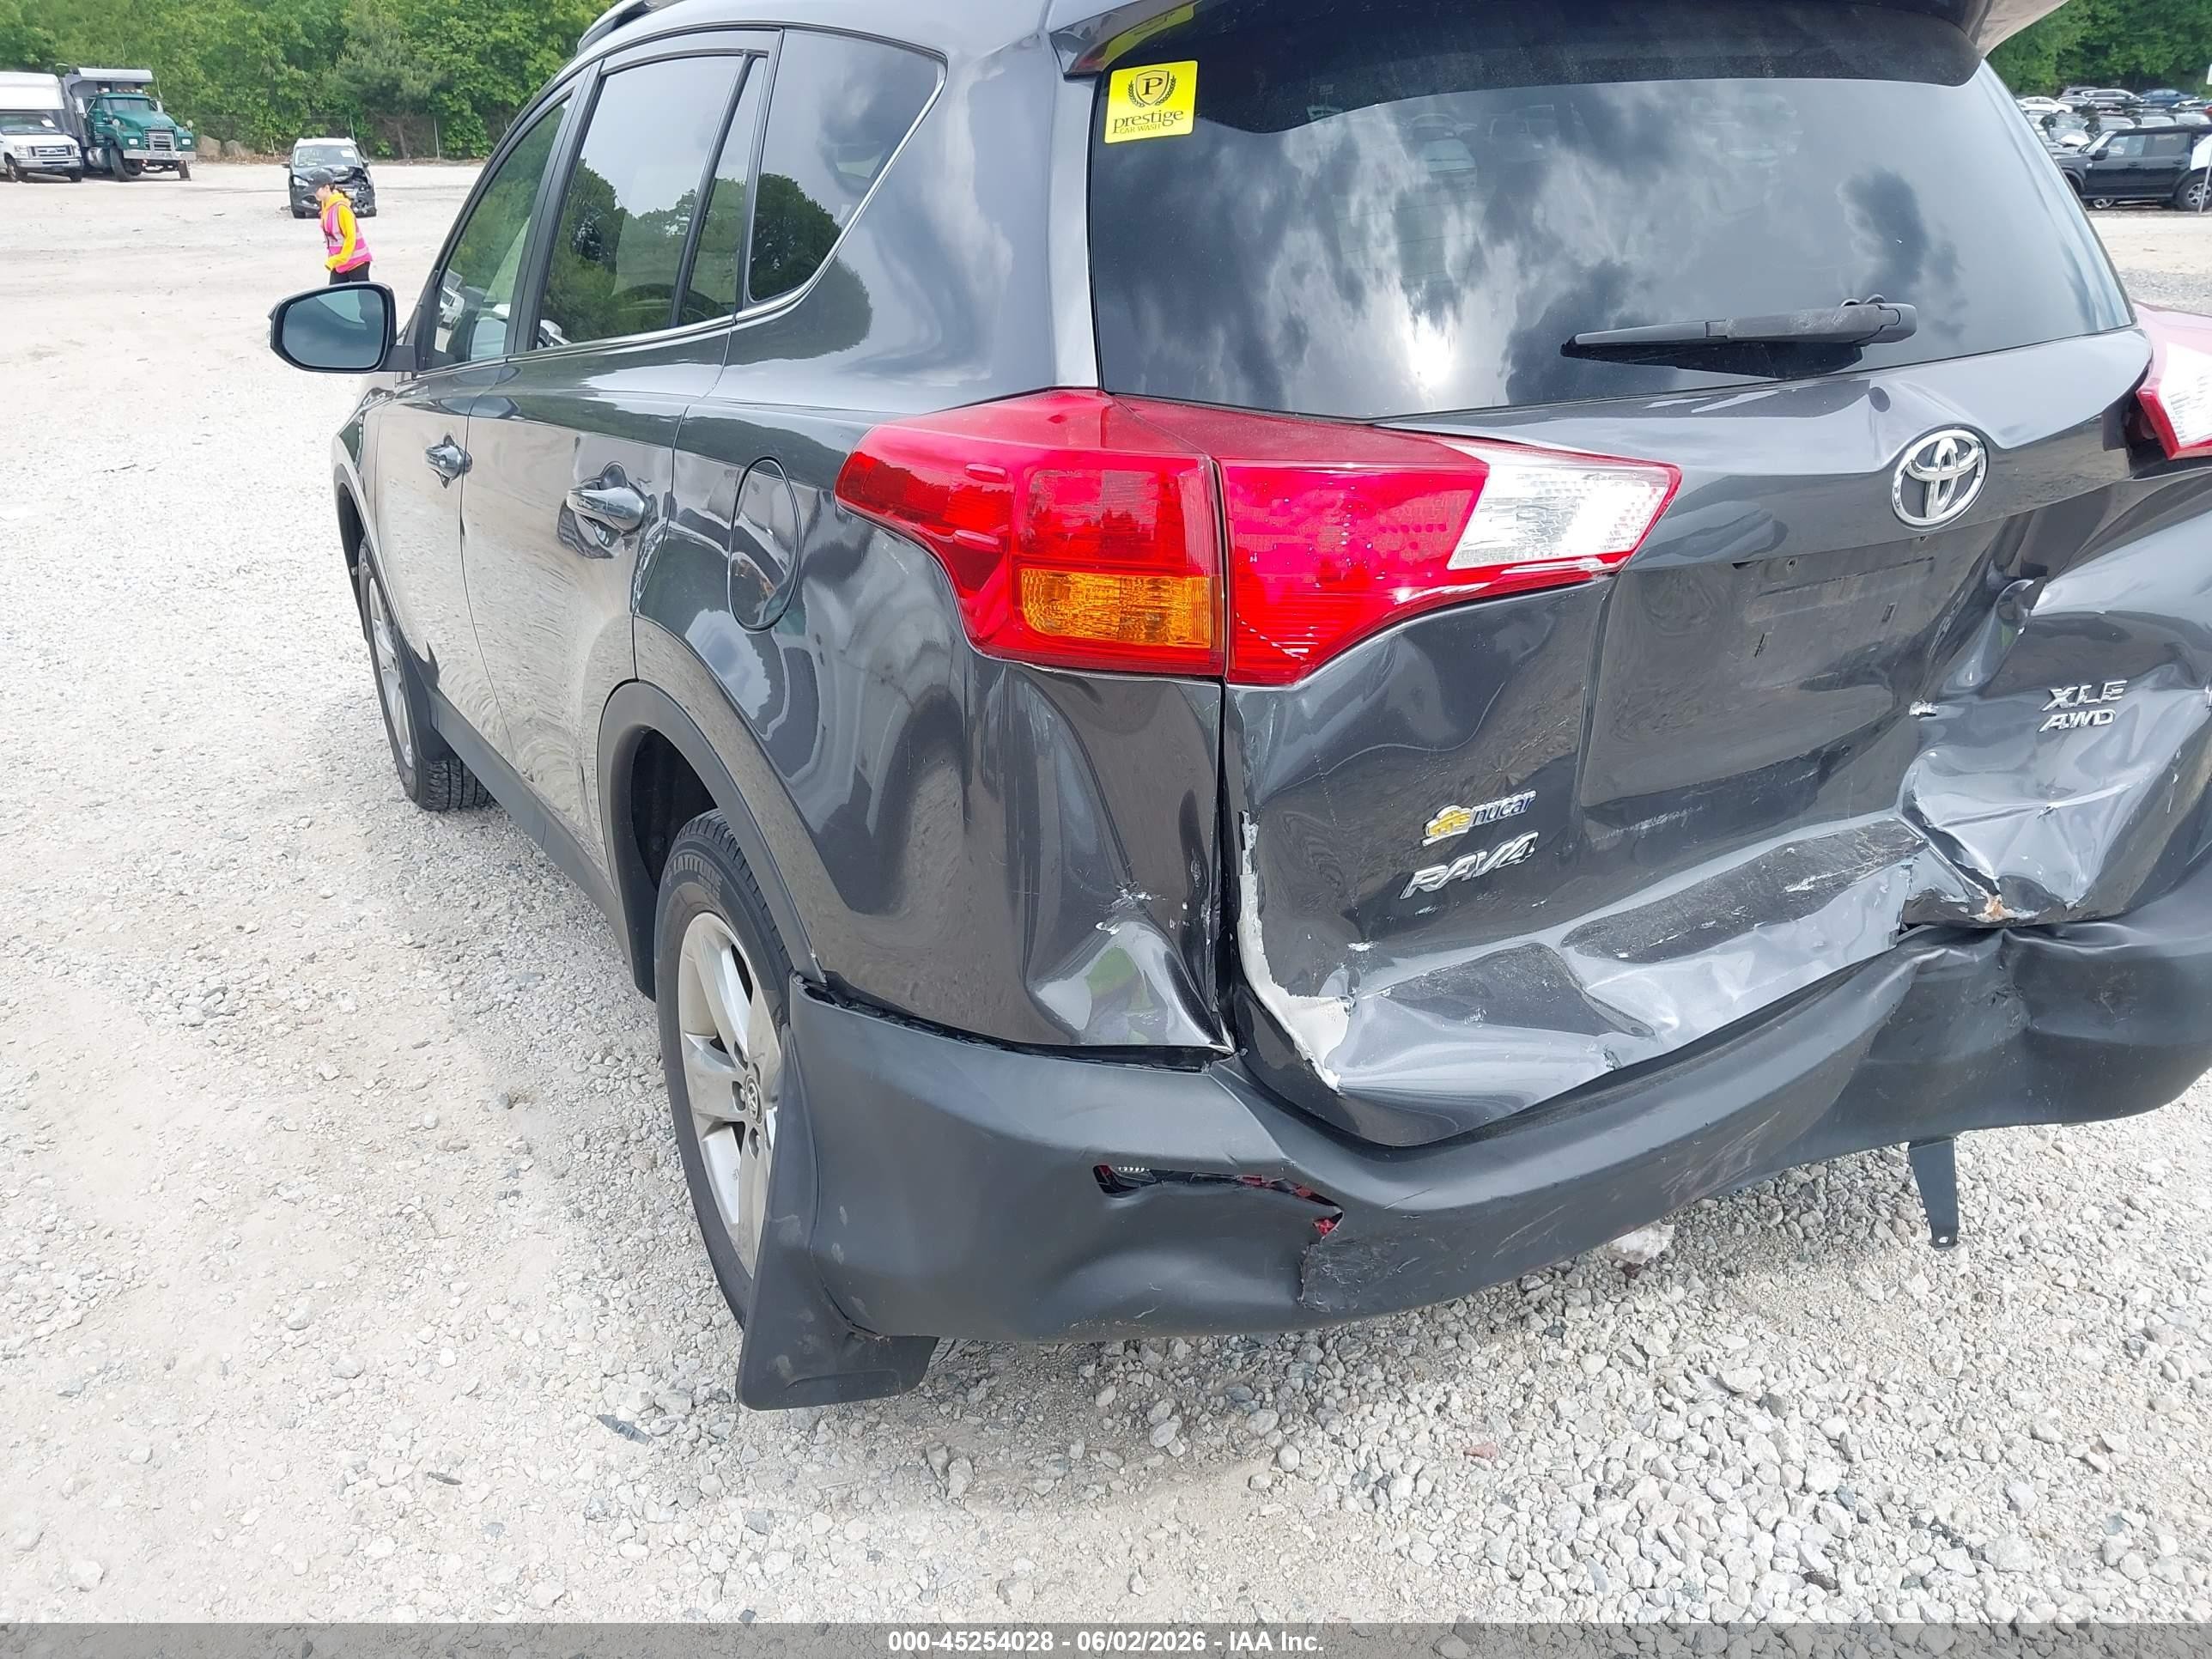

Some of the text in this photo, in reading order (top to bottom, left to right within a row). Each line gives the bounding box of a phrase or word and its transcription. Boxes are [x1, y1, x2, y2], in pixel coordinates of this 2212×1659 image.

[1141, 77, 1164, 96] P
[1112, 109, 1184, 135] prestige
[1120, 123, 1161, 135] CAR WASH
[2039, 679, 2129, 712] XLE
[2037, 708, 2117, 733] AWD
[1472, 790, 1537, 826] nucar
[673, 854, 722, 891] LATITUDE
[1400, 830, 1540, 900] RAV4
